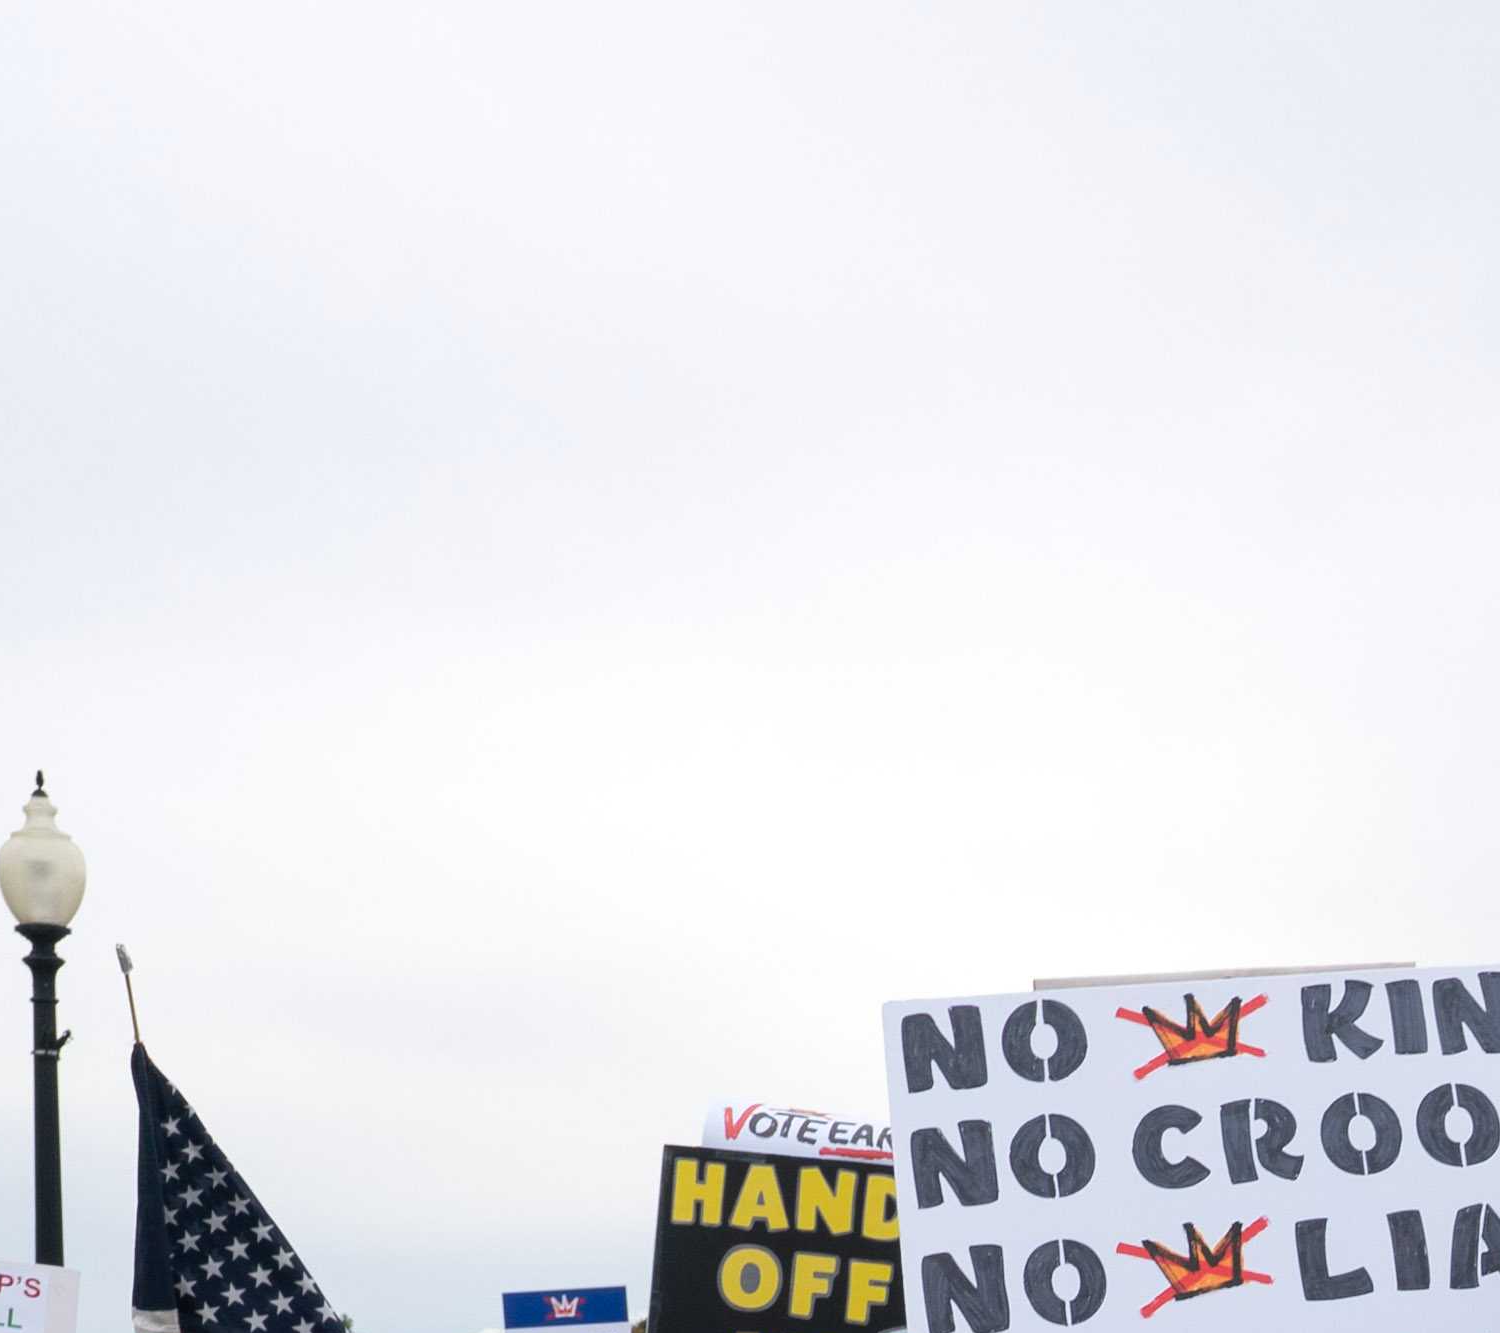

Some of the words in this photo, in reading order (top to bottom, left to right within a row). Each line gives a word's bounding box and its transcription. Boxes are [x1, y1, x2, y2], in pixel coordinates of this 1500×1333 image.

[901, 1000, 1087, 1093] NO
[724, 1103, 819, 1144] VOTE
[910, 1113, 1095, 1208] NO
[670, 1157, 900, 1241] HAND
[718, 1244, 894, 1324] OFF
